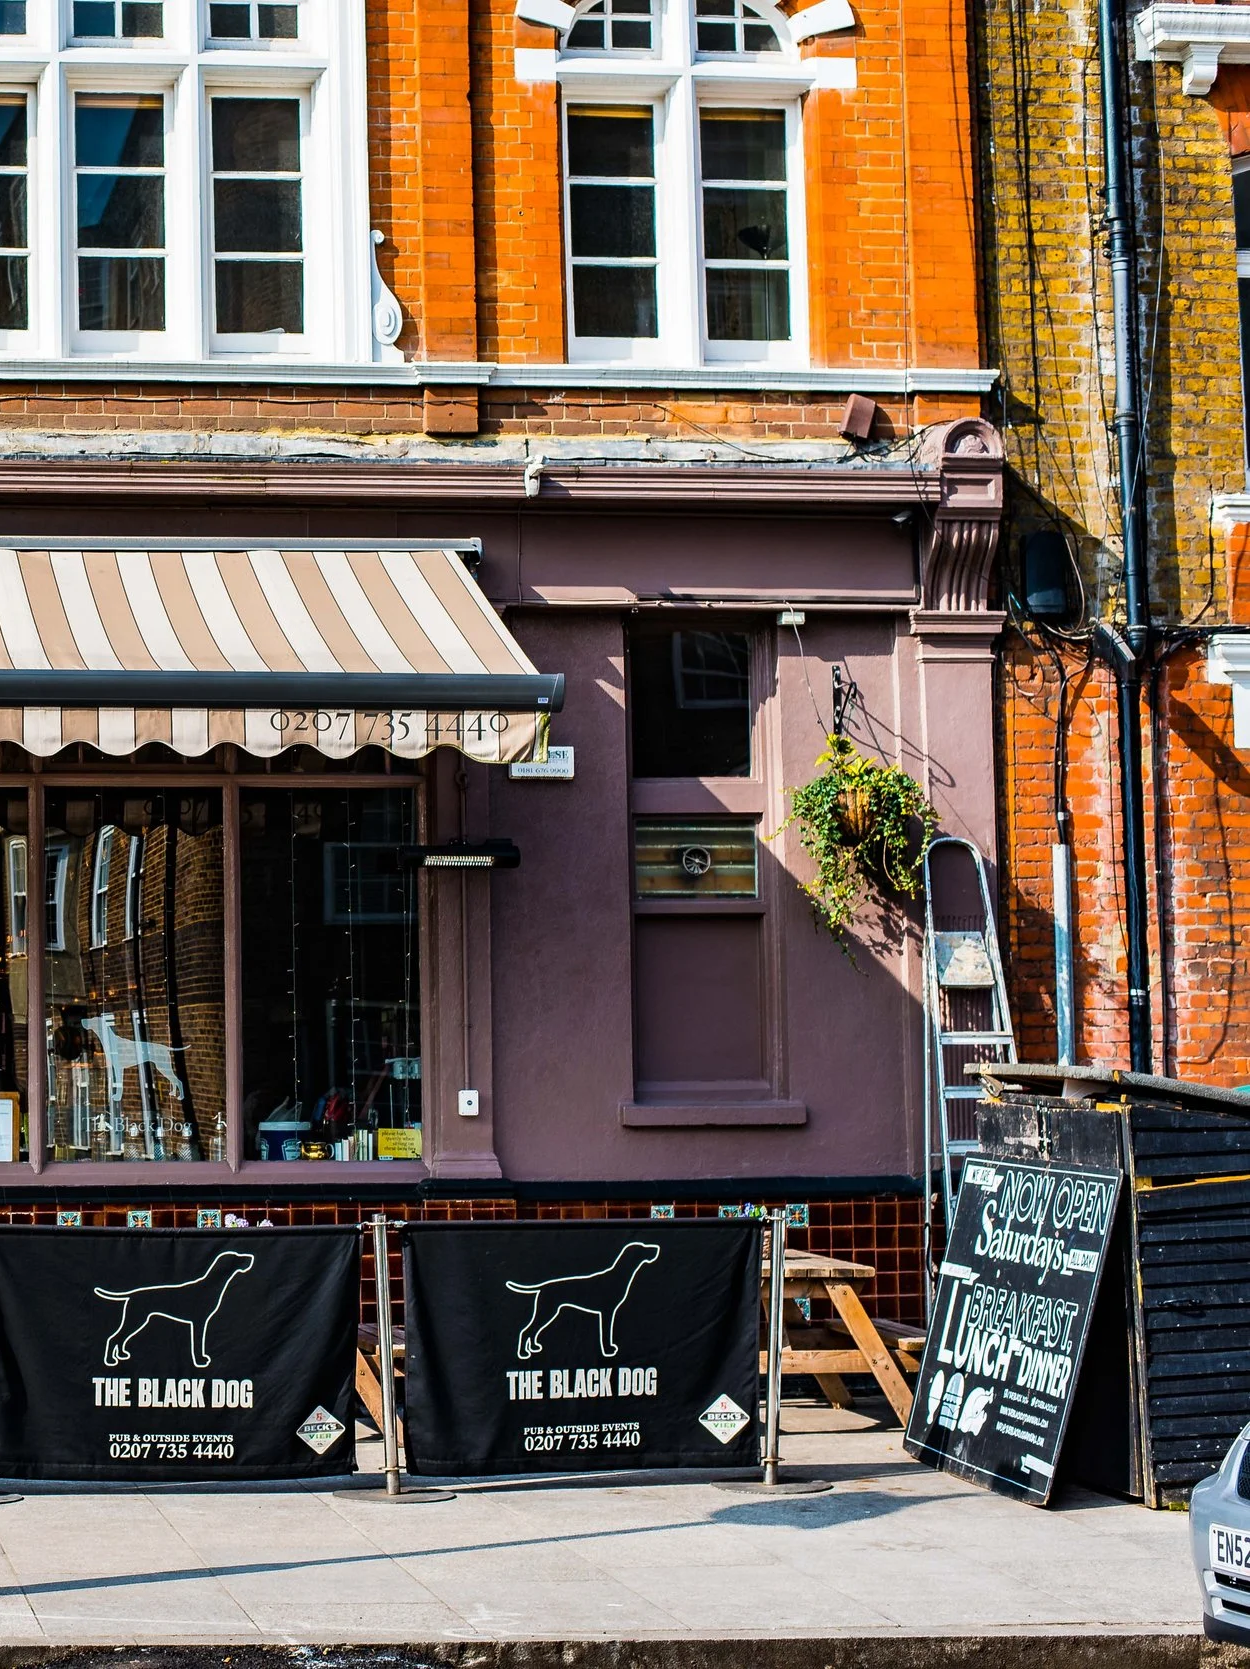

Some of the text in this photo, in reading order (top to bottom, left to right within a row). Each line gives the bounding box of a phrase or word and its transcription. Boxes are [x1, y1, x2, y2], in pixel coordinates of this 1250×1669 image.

[270, 711, 510, 741] 0207 735 4440
[115, 1117, 156, 1132] Black
[160, 1117, 193, 1135] Dog
[999, 1170, 1114, 1235] NOW OPEN
[937, 1279, 1072, 1399] LUNCH DINNER
[92, 1377, 254, 1409] THE BLACK DOG
[506, 1367, 657, 1400] THE BLACK DOG
[109, 1433, 234, 1443] PUB & OUTSIDE EVENTS
[524, 1422, 640, 1436] PUB & OUTSIDE EVENTS
[524, 1431, 641, 1452] 0207 735 4440
[109, 1442, 235, 1459] 0207 735 4440
